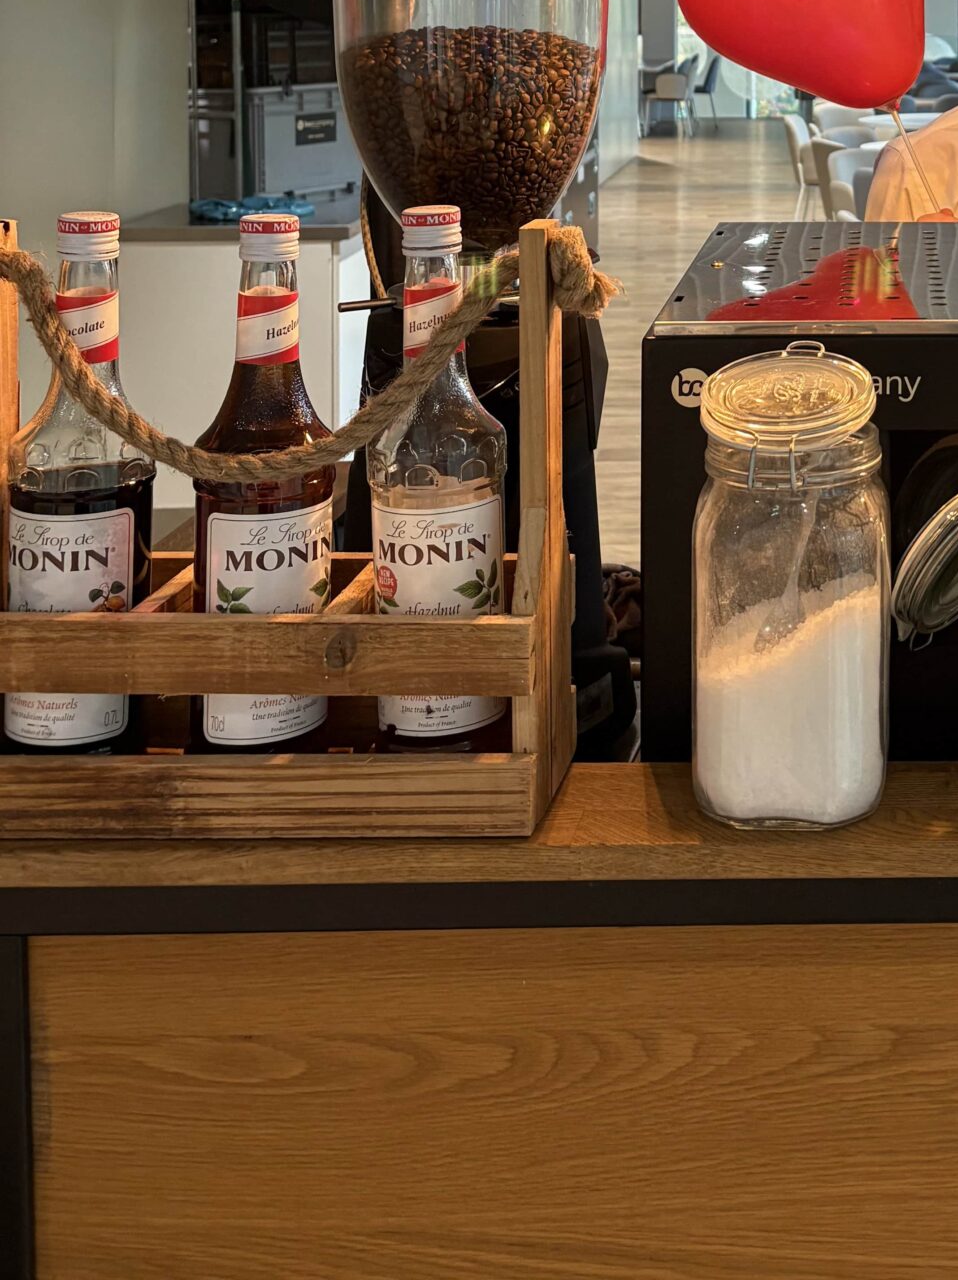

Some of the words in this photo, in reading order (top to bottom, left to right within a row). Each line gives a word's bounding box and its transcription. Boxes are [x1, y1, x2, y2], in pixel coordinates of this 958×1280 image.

[409, 313, 450, 333] Hazelnu
[12, 524, 26, 542] Le
[28, 525, 70, 551] Sirop
[75, 534, 94, 545] de
[240, 526, 268, 545] Le
[271, 522, 311, 543] Sirop
[315, 522, 326, 534] de
[386, 520, 406, 538] Le
[410, 520, 453, 542] Sirop
[458, 523, 474, 534] de
[225, 532, 331, 572] MONIN
[379, 533, 487, 566] MONIN
